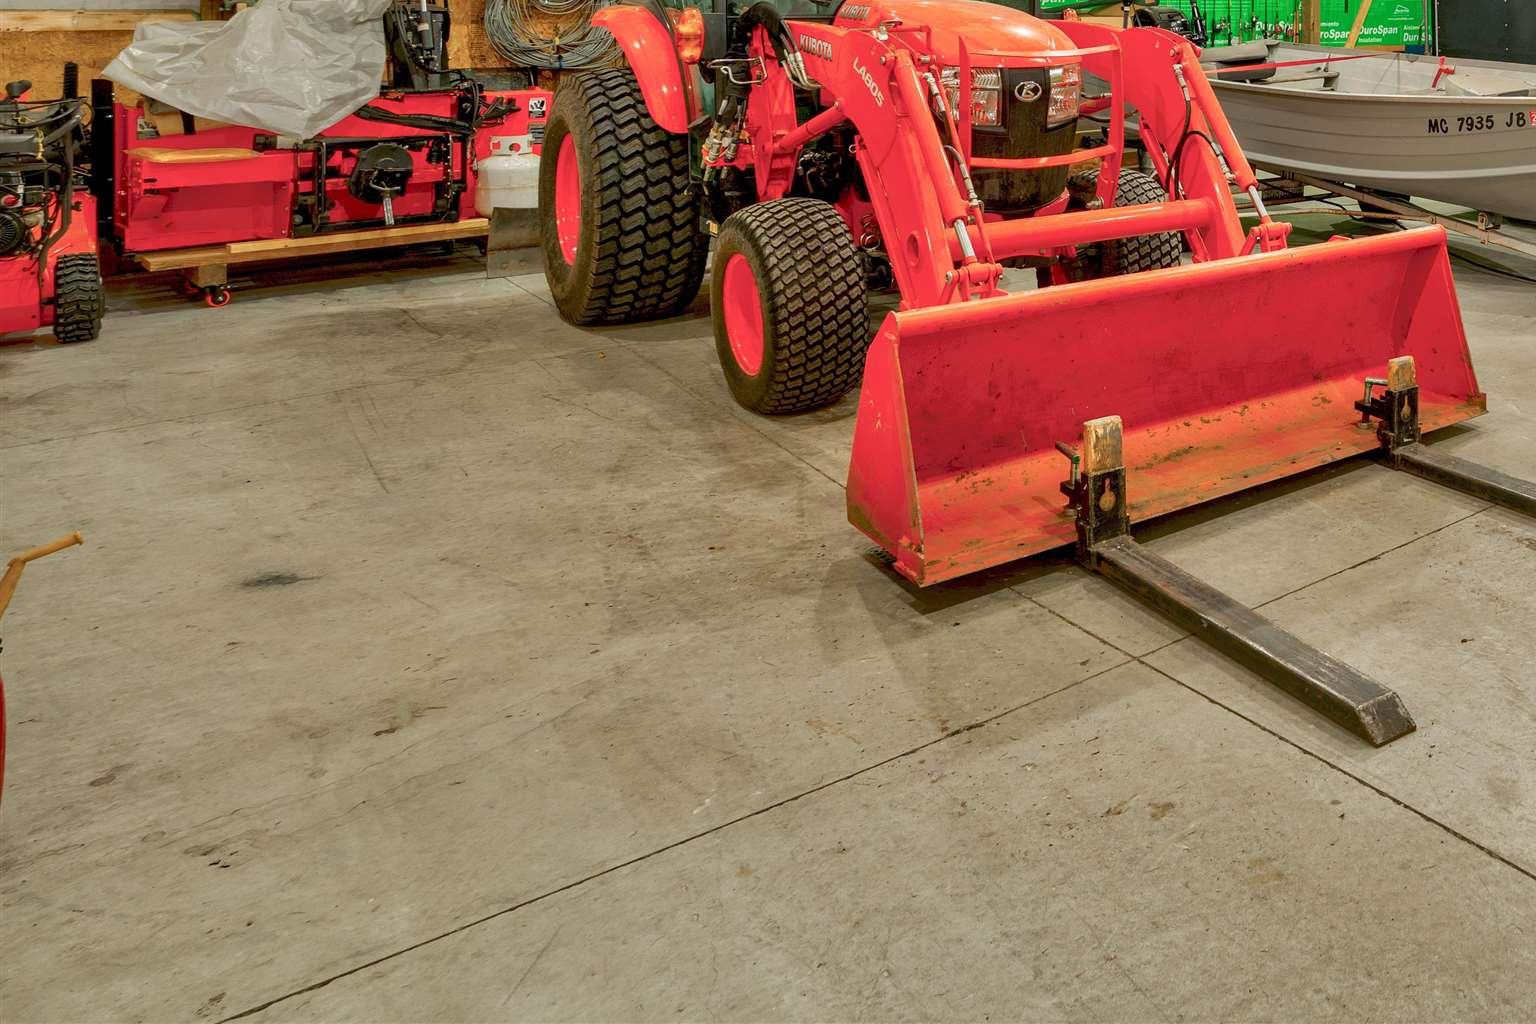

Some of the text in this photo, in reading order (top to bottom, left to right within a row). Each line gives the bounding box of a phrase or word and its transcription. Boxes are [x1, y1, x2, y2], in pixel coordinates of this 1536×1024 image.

[800, 33, 832, 61] KUBOTA
[853, 56, 884, 107] LA805
[1428, 111, 1526, 133] MC 7935 JB
